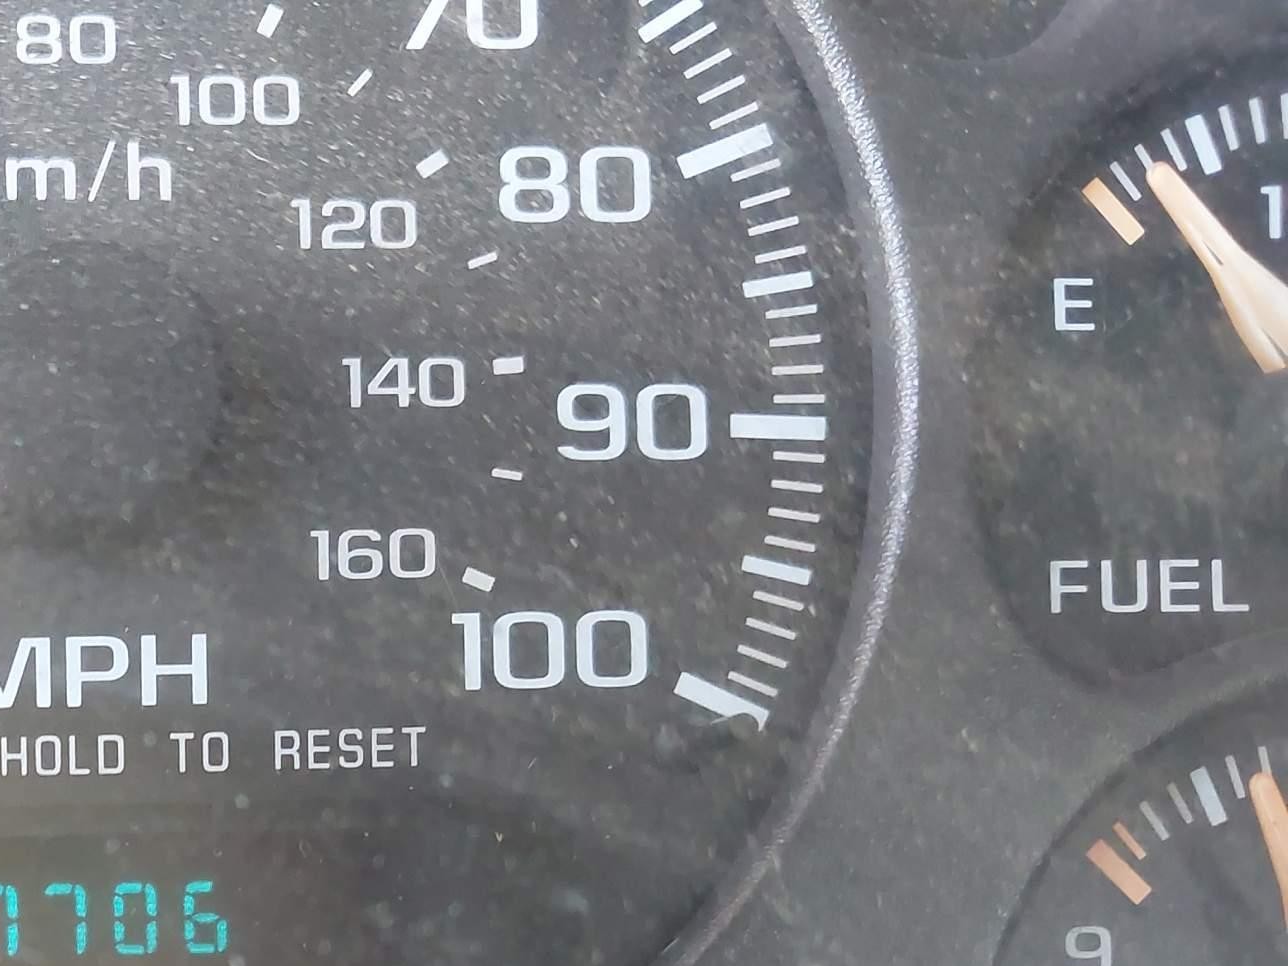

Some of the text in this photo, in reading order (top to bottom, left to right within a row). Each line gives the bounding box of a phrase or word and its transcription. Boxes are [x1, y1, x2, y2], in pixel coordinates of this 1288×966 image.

[17, 13, 120, 64] 80
[170, 75, 299, 125] 100
[499, 146, 651, 222] 80
[291, 198, 416, 249] 120
[1054, 278, 1095, 330] E
[342, 358, 464, 407] 140
[557, 384, 707, 460] 90
[311, 529, 435, 580] 160
[1051, 560, 1249, 613] FUEL
[452, 610, 647, 690] 100
[170, 732, 228, 772] TO
[275, 727, 425, 769] RESET
